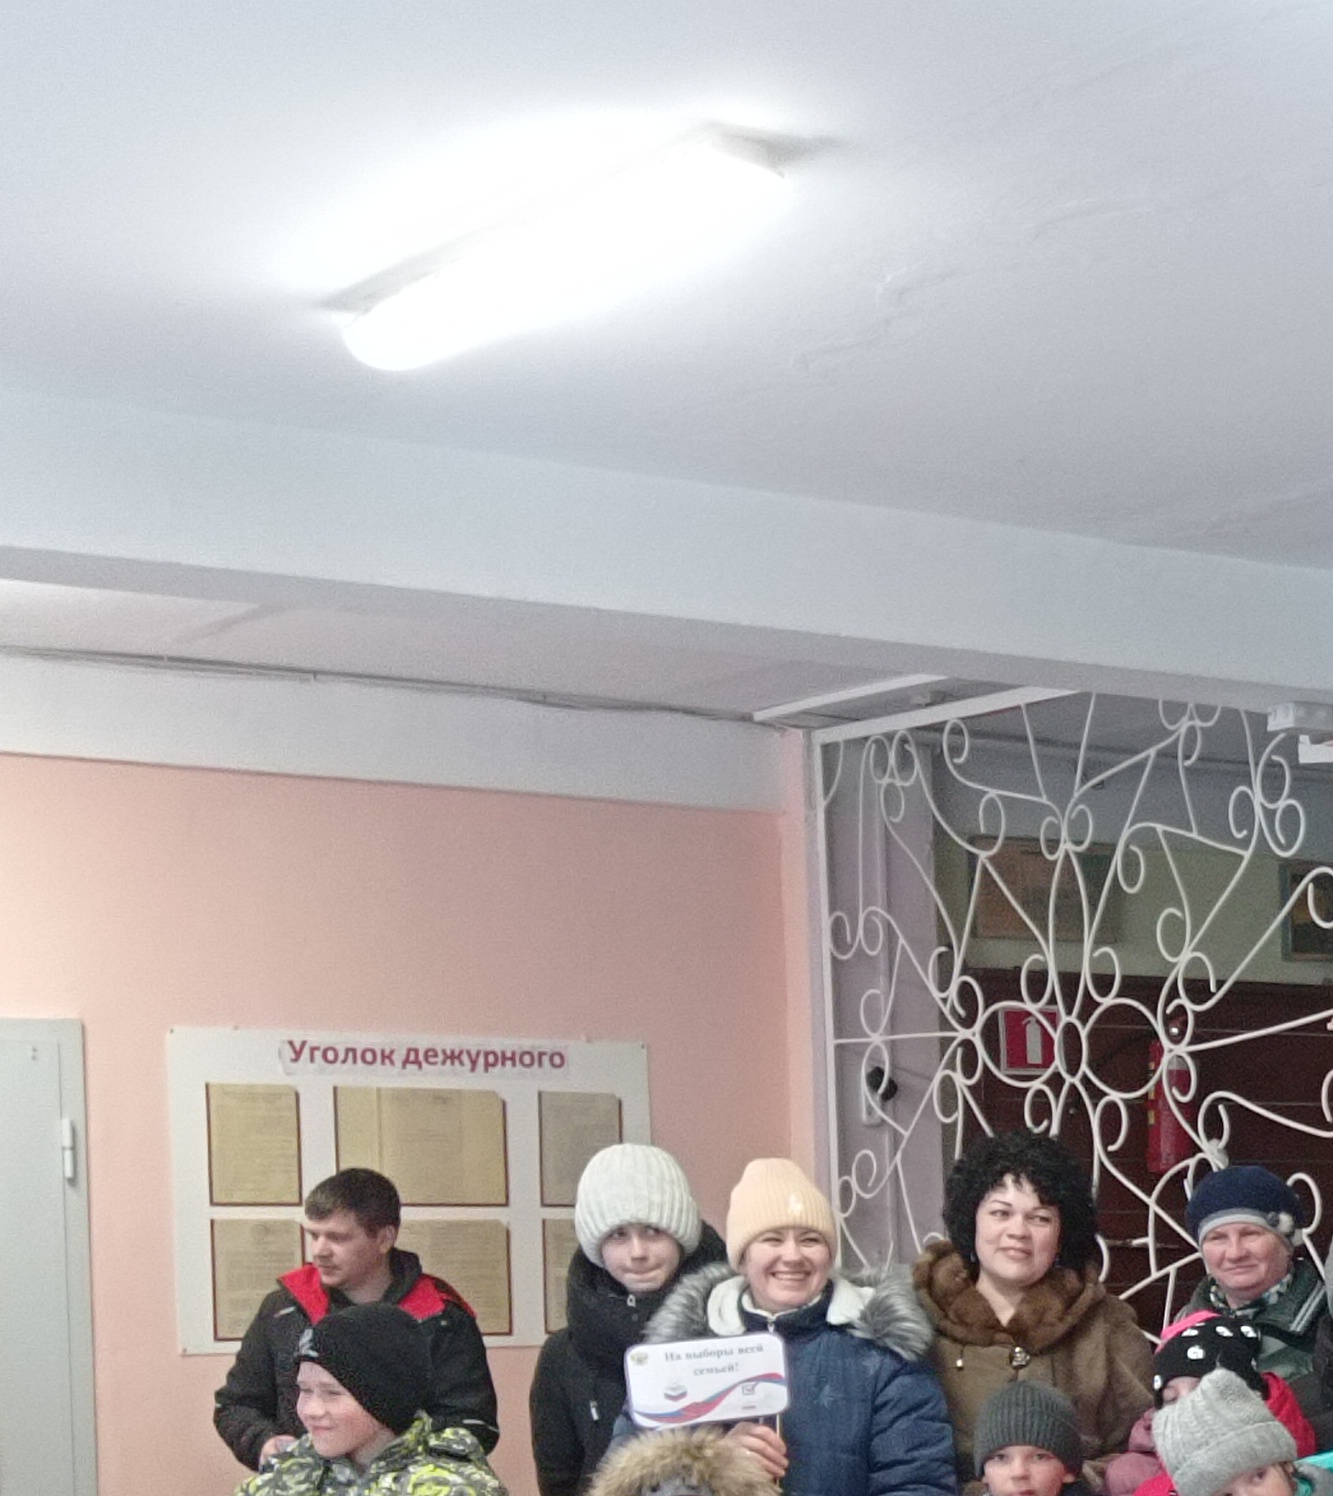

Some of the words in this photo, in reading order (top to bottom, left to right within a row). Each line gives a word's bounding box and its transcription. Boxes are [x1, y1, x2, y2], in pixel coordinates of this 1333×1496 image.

[288, 1040, 395, 1066] Уголок
[402, 1046, 566, 1073] дежурного
[685, 1348, 733, 1360] выборы
